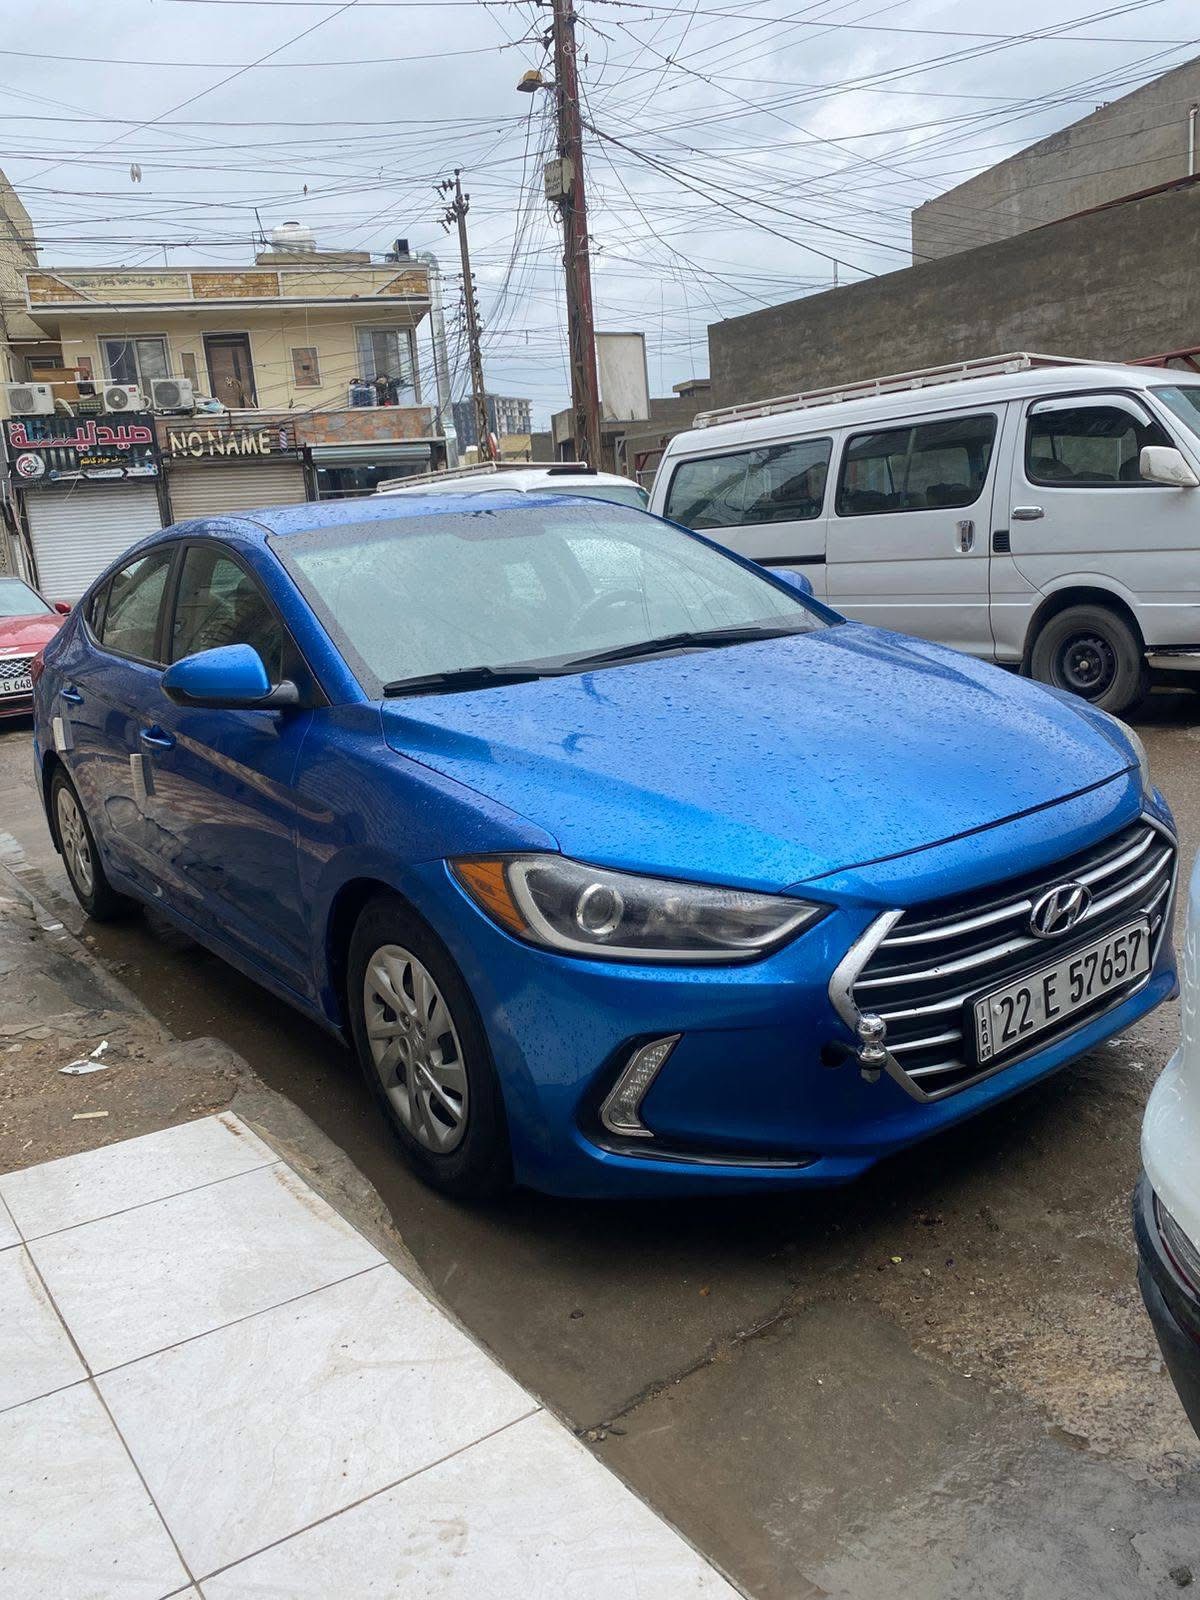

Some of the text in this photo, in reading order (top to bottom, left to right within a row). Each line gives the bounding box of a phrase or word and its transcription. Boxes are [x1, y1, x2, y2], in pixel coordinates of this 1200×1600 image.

[10, 420, 153, 451] صيدلية
[169, 429, 271, 457] NO NAME
[999, 928, 1142, 1043] 22 E 57657
